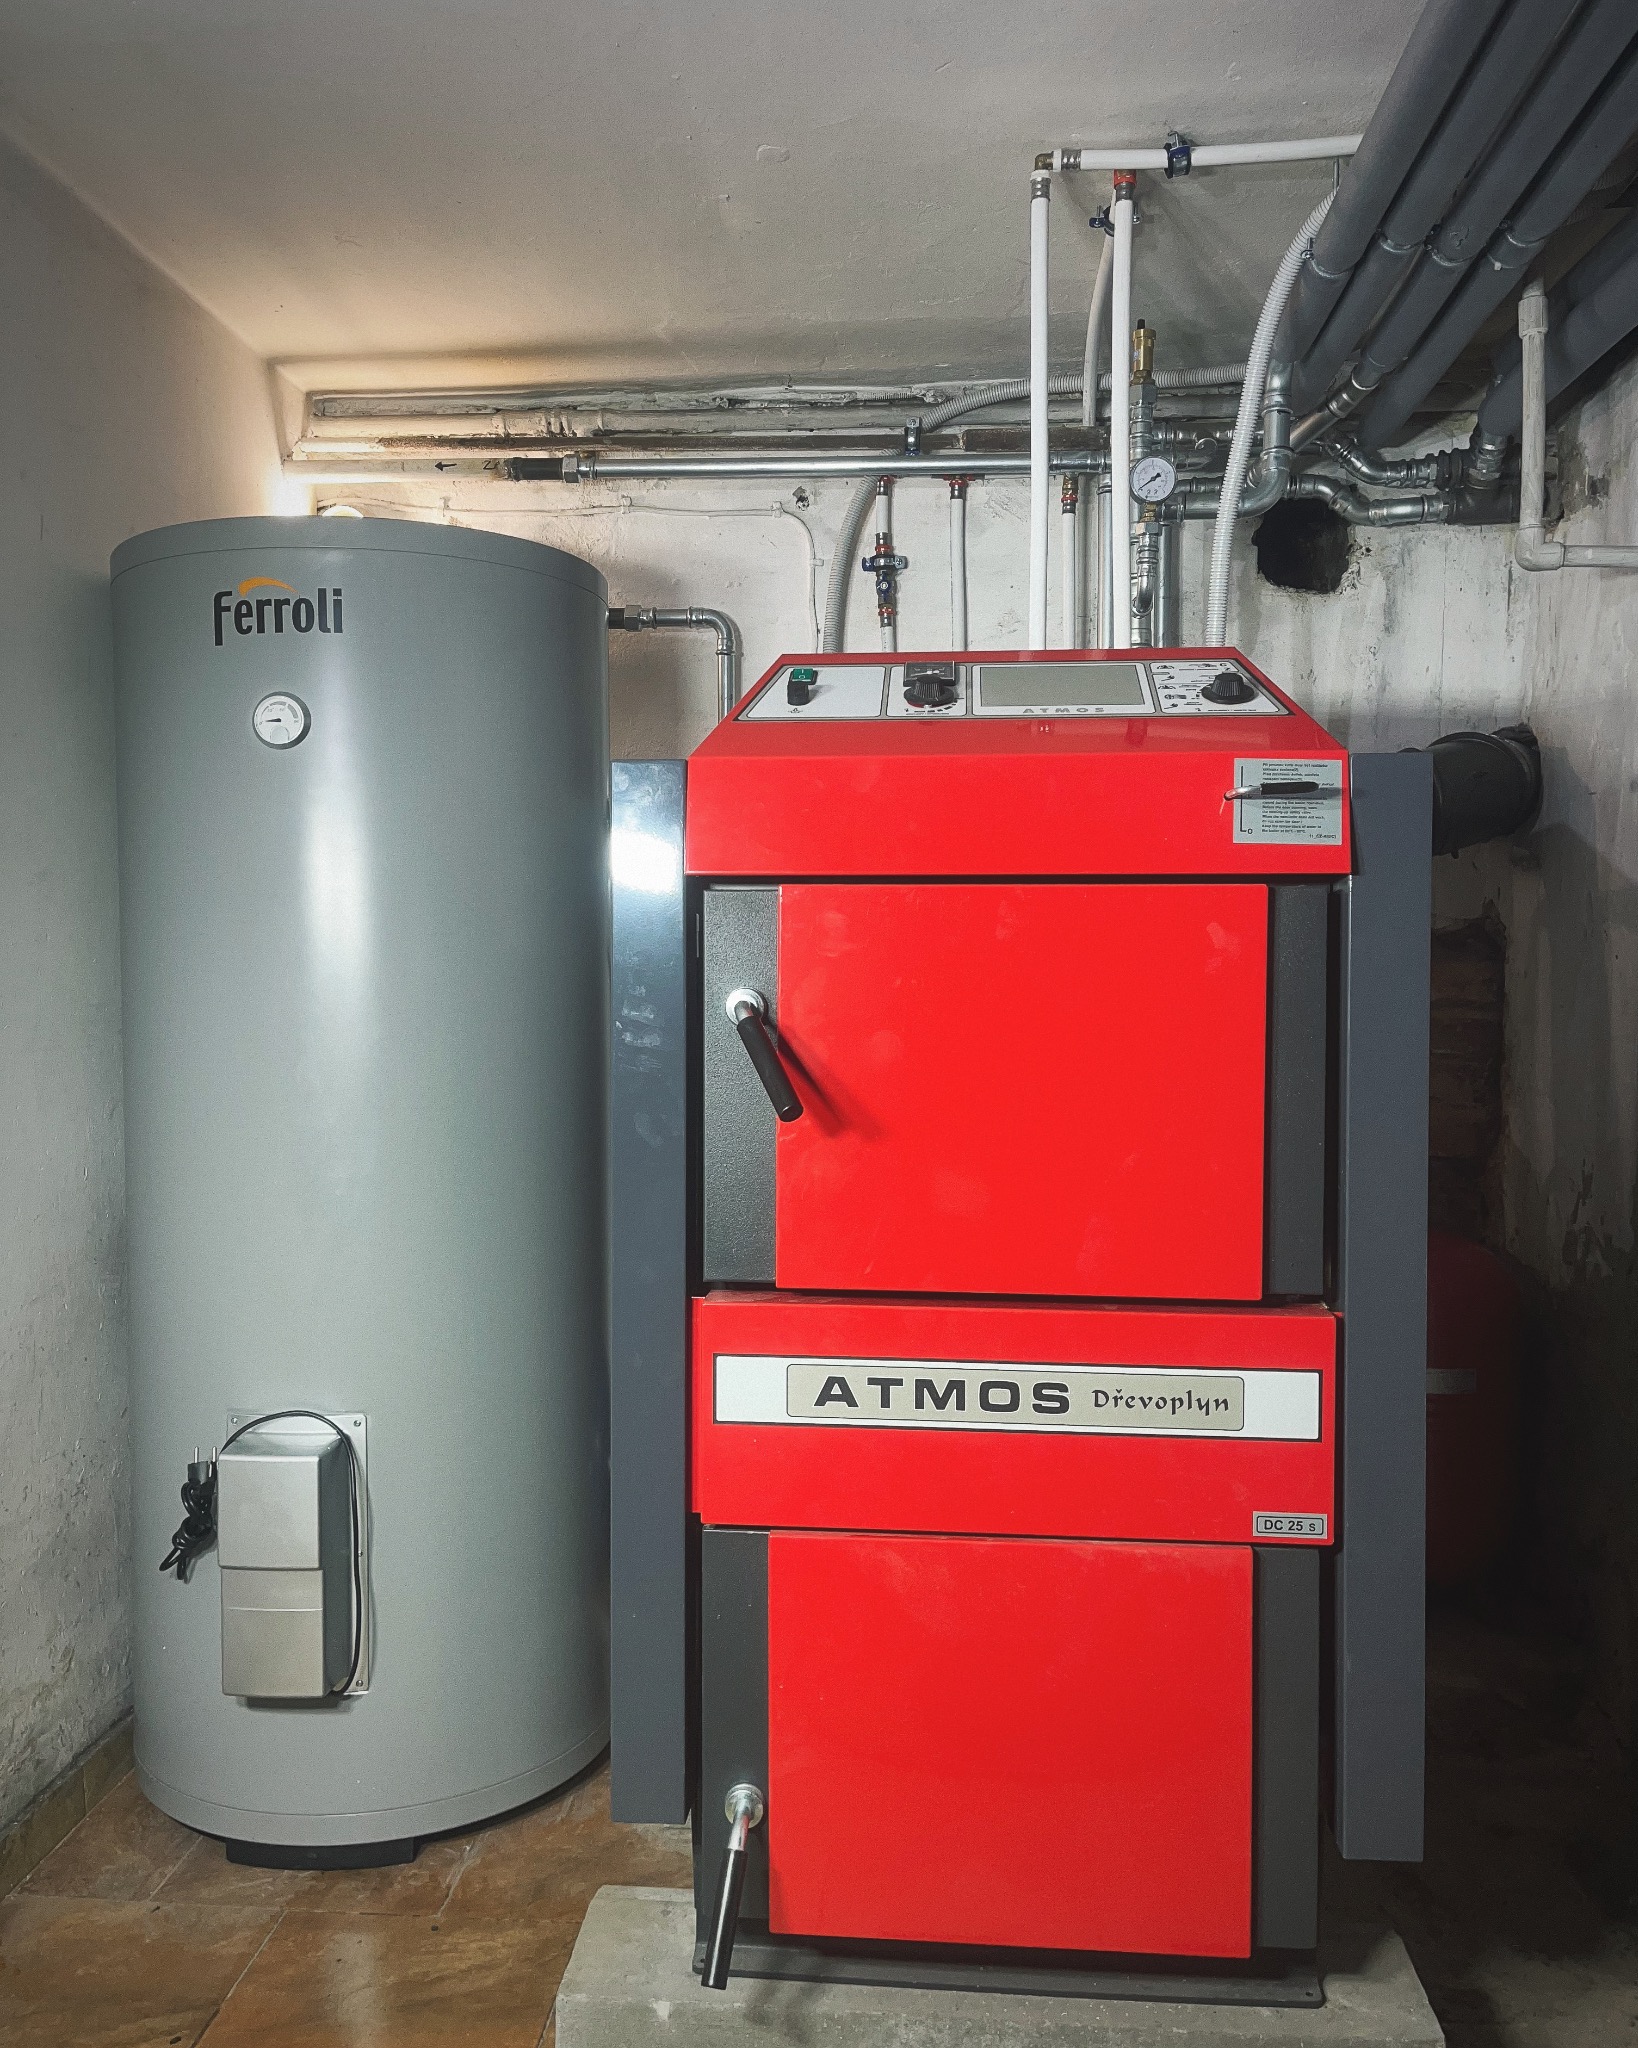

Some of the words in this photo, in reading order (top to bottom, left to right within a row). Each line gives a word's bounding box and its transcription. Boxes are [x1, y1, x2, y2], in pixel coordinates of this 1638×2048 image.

[813, 1375, 1071, 1416] ATMOS
[1091, 1388, 1230, 1416] Dřevoplyn
[1264, 1519, 1284, 1531] DC
[1288, 1520, 1304, 1532] 25
